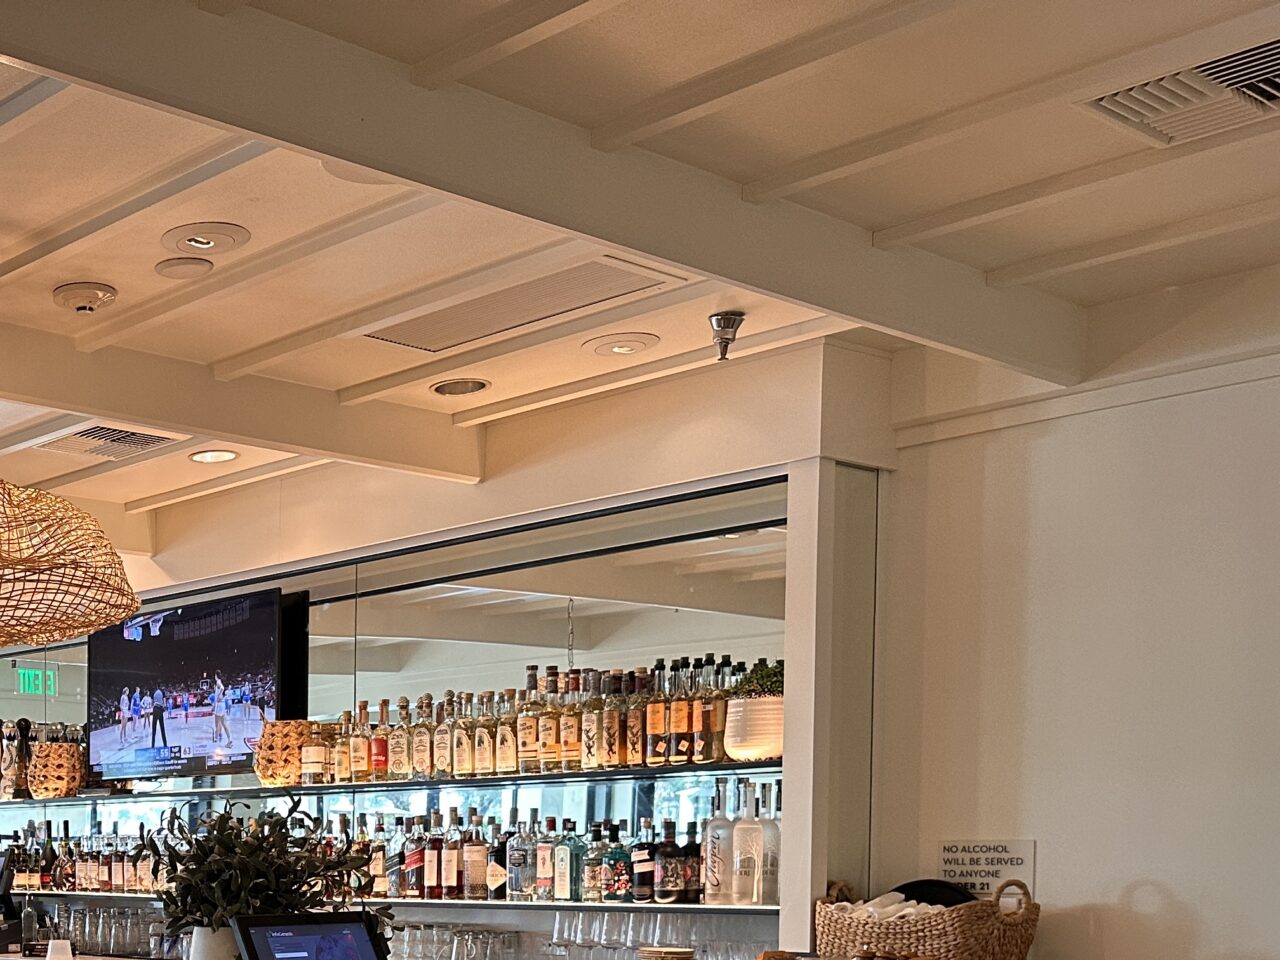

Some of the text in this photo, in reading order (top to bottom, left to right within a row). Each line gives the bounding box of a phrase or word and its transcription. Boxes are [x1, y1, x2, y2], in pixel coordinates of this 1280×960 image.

[943, 845, 1010, 853] NO ALCOHOL
[943, 857, 1024, 866] WILL BE SERVED
[942, 869, 1001, 878] TO ANYONE
[954, 882, 990, 890] DER 21
